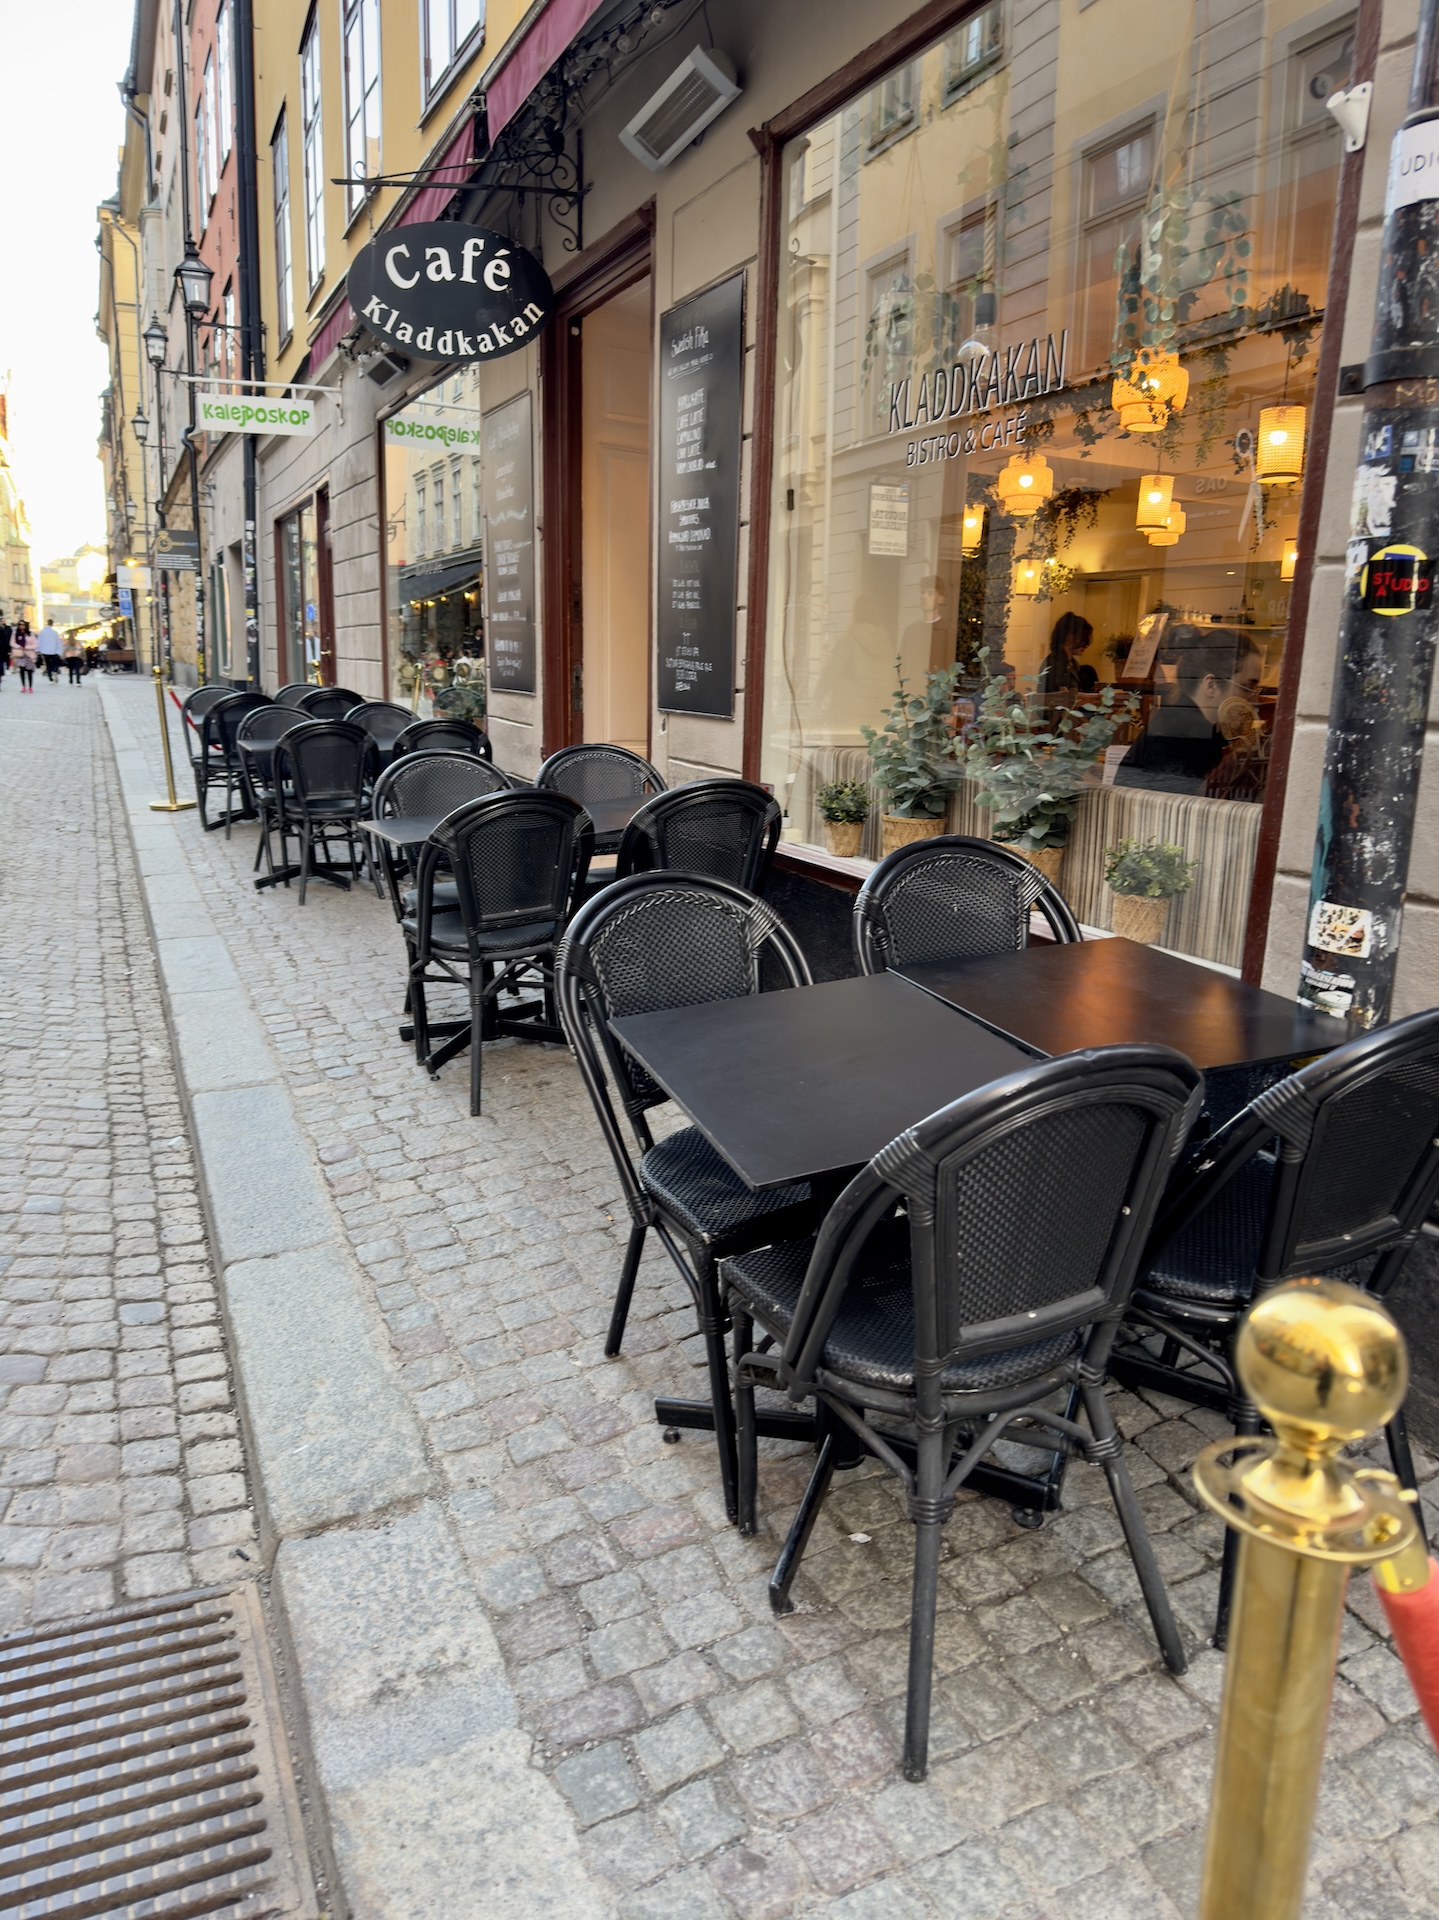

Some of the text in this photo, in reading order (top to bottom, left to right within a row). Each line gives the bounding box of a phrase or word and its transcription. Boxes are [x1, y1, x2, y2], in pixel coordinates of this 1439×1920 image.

[385, 237, 511, 292] Café
[361, 295, 545, 356] Kladdkakan
[889, 328, 1068, 433] KLADDKAKAN
[906, 409, 1028, 469] BISTRO & CAFÉ
[1372, 572, 1430, 593] STUDO
